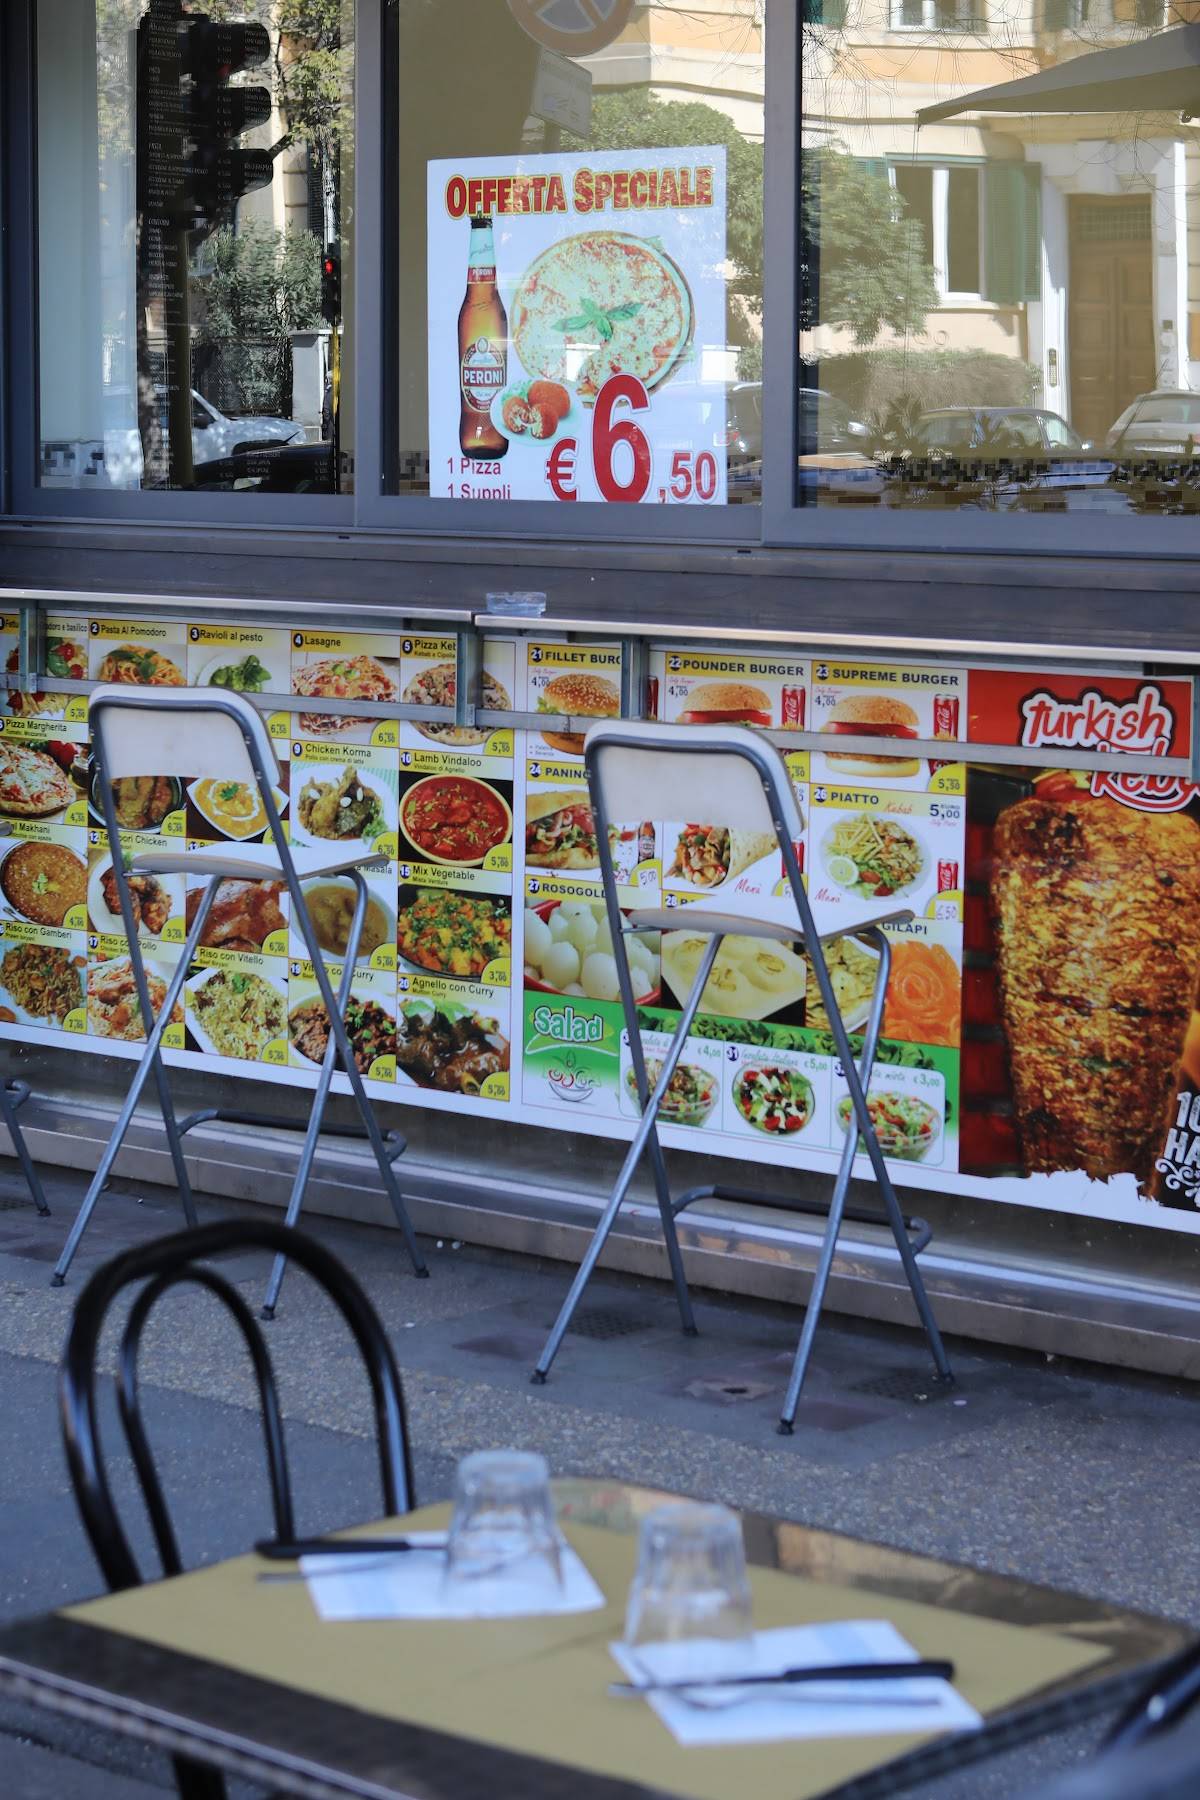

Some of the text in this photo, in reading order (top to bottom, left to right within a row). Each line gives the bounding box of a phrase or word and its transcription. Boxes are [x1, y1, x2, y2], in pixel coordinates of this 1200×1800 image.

[446, 168, 713, 218] OFFERTA SPECIALE
[464, 370, 502, 384] PERONI
[447, 458, 501, 475] 1 Pizza
[448, 485, 454, 499] 1
[101, 625, 120, 635] Pasta
[131, 627, 167, 637] Pomodoro
[192, 628, 263, 643] 3 Ravioli al pesto
[295, 635, 341, 648] 4 Lasagne
[404, 641, 411, 652] 5
[415, 640, 438, 650] Pizza
[545, 651, 587, 663] FILLET
[683, 660, 746, 673] POUNDER
[750, 664, 804, 676] BURGER
[833, 668, 897, 682] SUPREME
[902, 673, 959, 686] BURGER
[668, 685, 689, 697] 4,00
[815, 695, 836, 707] 4,00
[6, 719, 67, 732] Pizza Margherita
[294, 743, 371, 757] 9 Chicken Korma
[401, 752, 482, 767] 10 Lamb Vindaloo
[814, 788, 827, 801] 26
[831, 792, 879, 805] PIATTO
[930, 803, 960, 820] 5,00
[20, 823, 50, 834] Makhani
[90, 831, 99, 842] 12
[136, 834, 168, 847] Chicken
[413, 865, 428, 876] Mix
[432, 868, 475, 881] Vegetable
[528, 879, 540, 892] 27
[6, 923, 72, 939] Riso con Gamberi
[100, 935, 117, 946] Riso
[200, 948, 264, 966] Riso con Vitello
[412, 977, 446, 991] Agnello
[449, 983, 467, 993] con
[468, 984, 494, 998] Curry
[534, 1005, 603, 1042] Salad
[918, 1073, 940, 1087] 3,00
